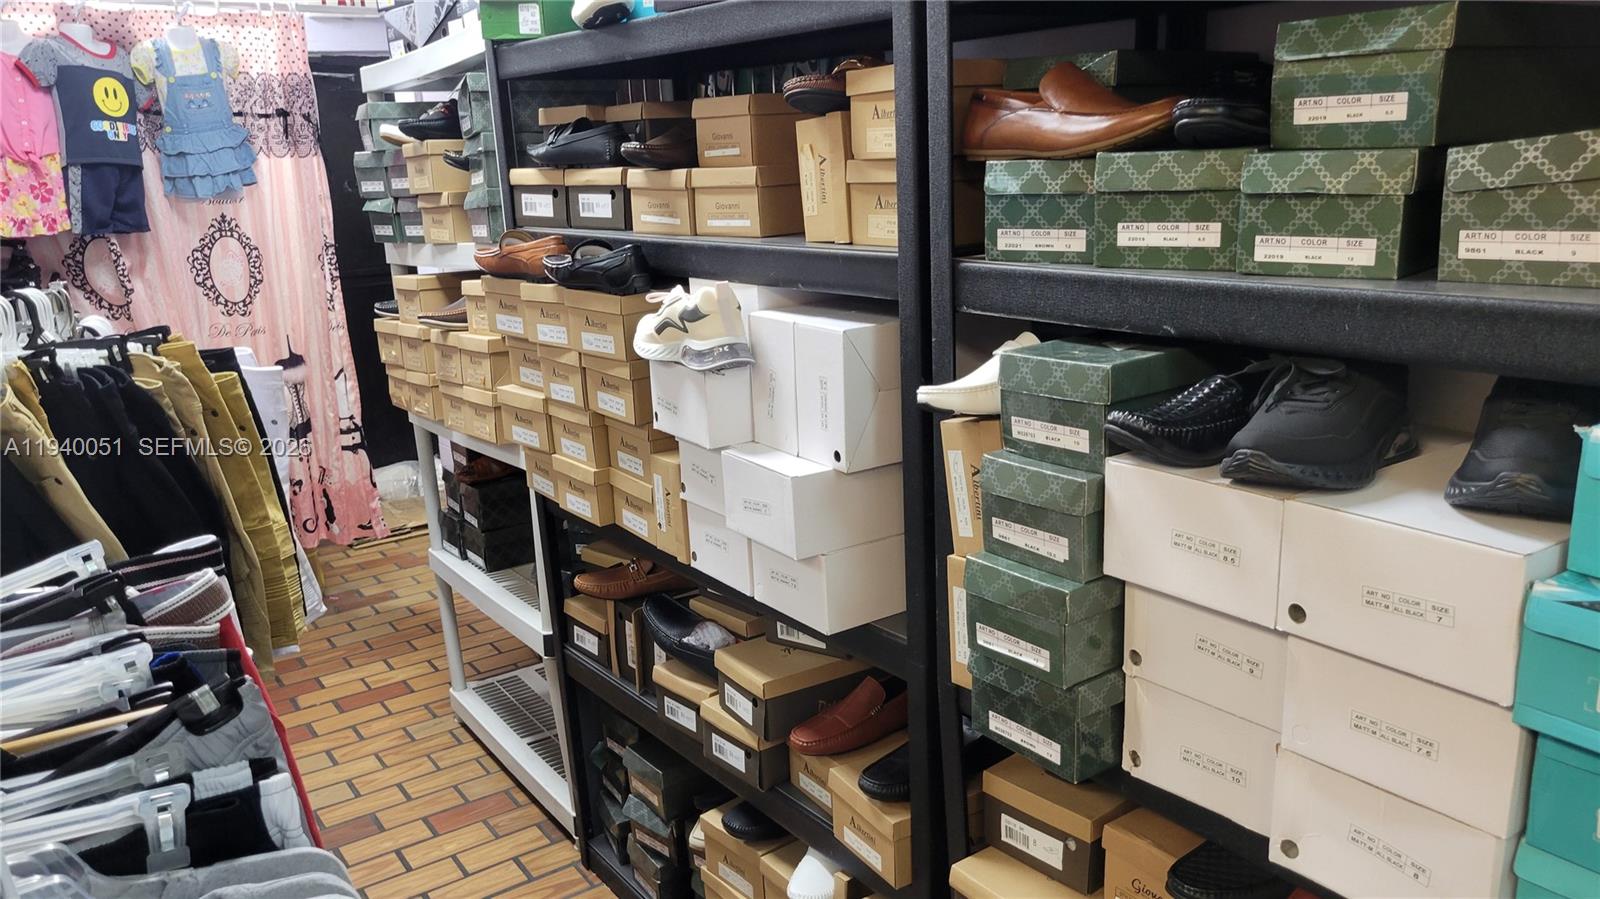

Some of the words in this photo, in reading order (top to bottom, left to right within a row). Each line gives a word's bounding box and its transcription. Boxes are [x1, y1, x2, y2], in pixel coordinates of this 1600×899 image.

[1336, 97, 1362, 105] COLOR
[1515, 233, 1547, 241] COLOR
[1570, 233, 1591, 241] SIZE
[1040, 423, 1057, 431] COLOR
[1020, 527, 1038, 536] COLOR
[1198, 539, 1216, 548] COLOR
[1399, 597, 1421, 606] COLOR
[1003, 635, 1020, 645] COLOR
[1030, 646, 1041, 654] SIZE
[1222, 648, 1239, 658] COLOR
[1016, 725, 1032, 736] COLOR
[1042, 738, 1053, 746] SIZE
[1385, 725, 1407, 737] COLOR
[1207, 758, 1223, 767] COLOR
[1231, 776, 1240, 784] 10
[1382, 845, 1401, 858] COLOR
